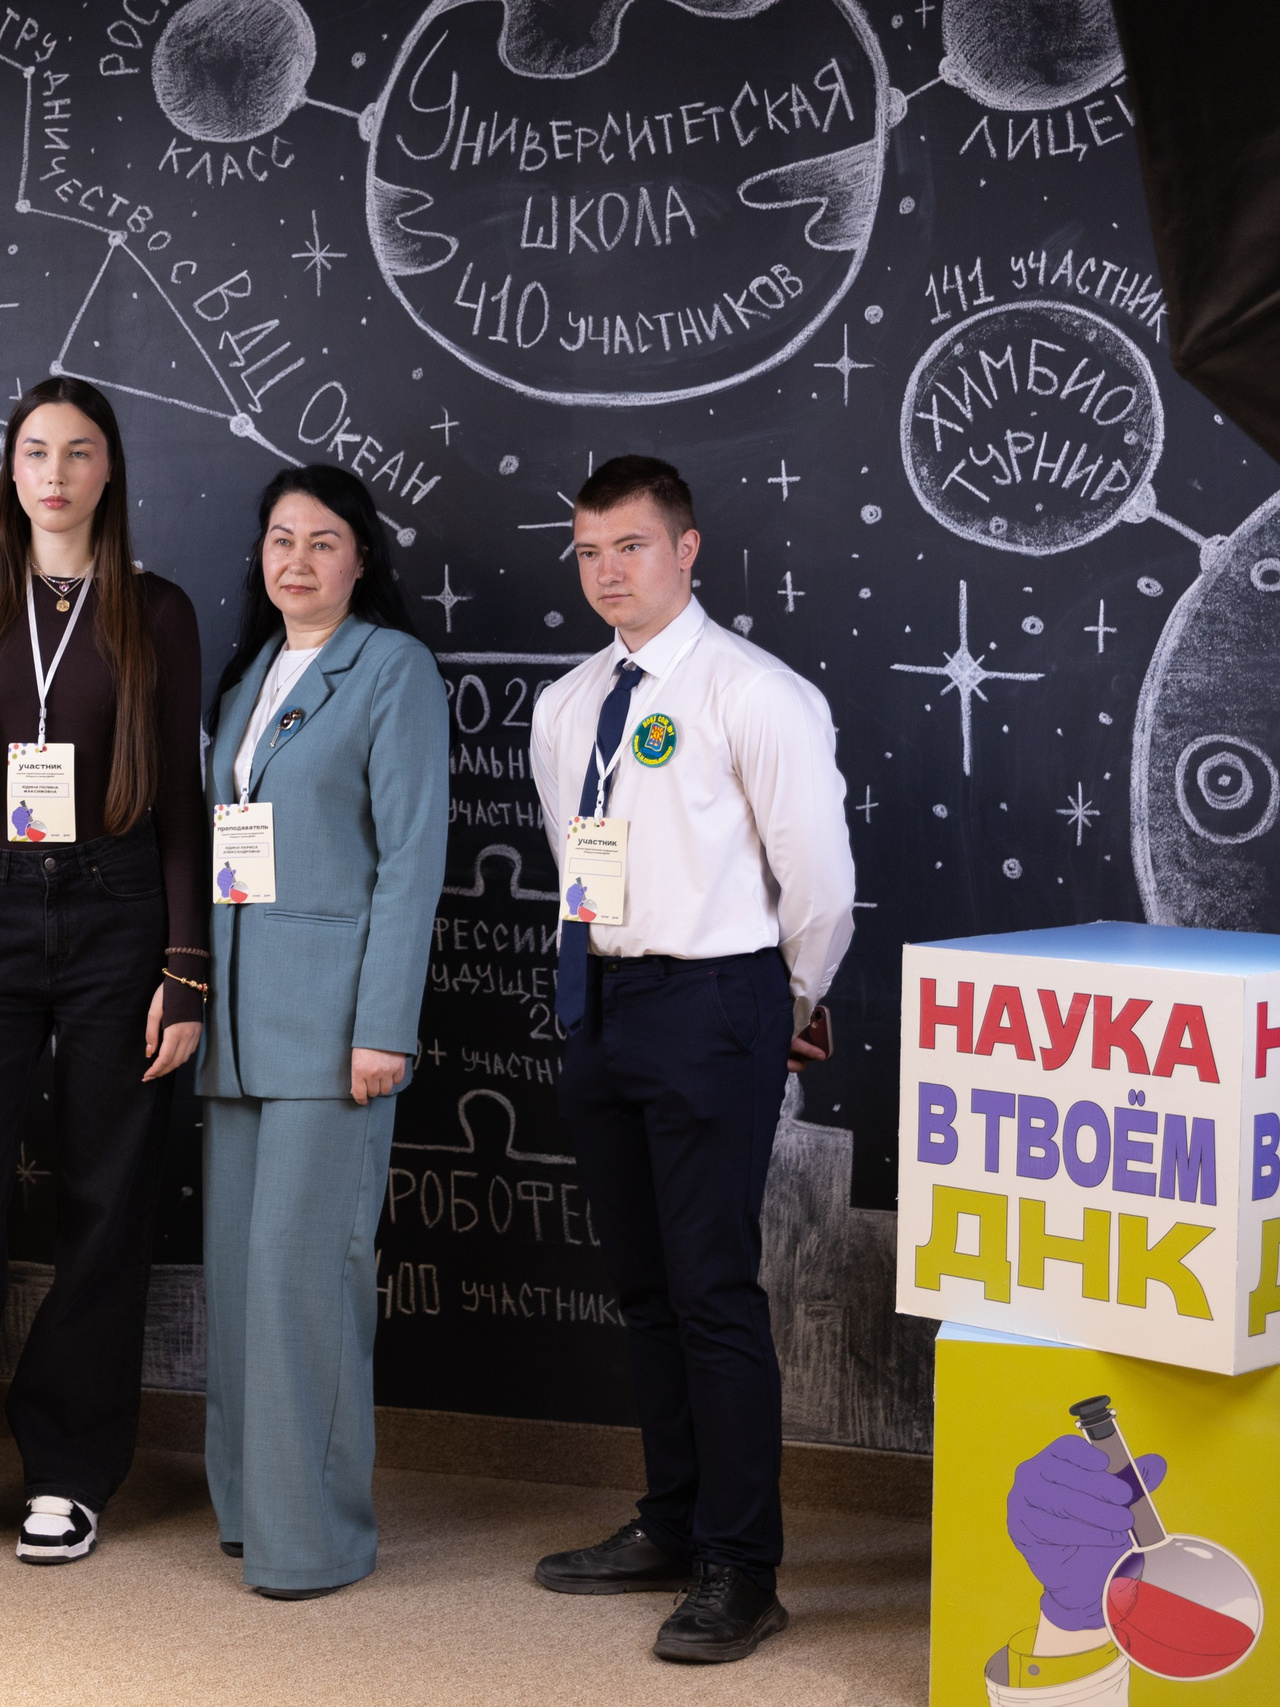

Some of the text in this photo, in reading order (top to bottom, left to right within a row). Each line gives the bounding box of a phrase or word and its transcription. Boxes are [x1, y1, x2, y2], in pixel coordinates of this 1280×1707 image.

[99, 0, 169, 76] РОС
[396, 30, 855, 171] УНИВЕРСИТЕТСКАЯ
[158, 135, 295, 186] КЛАСС
[520, 186, 697, 254] ШКОЛА
[455, 263, 804, 355] 410 УЧАСТНИКОВ
[925, 257, 995, 325] 141
[170, 260, 197, 284] С
[192, 270, 306, 413] ВДЦ
[299, 381, 441, 505] ОКЕАН
[915, 339, 1136, 452] ХИМБИО
[941, 428, 1131, 503] ТУРНИР
[18, 763, 62, 771] участник
[217, 825, 269, 833] преподаватель
[577, 837, 618, 847] участник
[462, 1047, 563, 1085] УЧАСТН
[919, 977, 1221, 1084] НАУКА
[917, 1081, 1217, 1206] В ТВОЁМ
[915, 1184, 1217, 1321] ДНК
[462, 1280, 627, 1328] УЧАСТНИК
